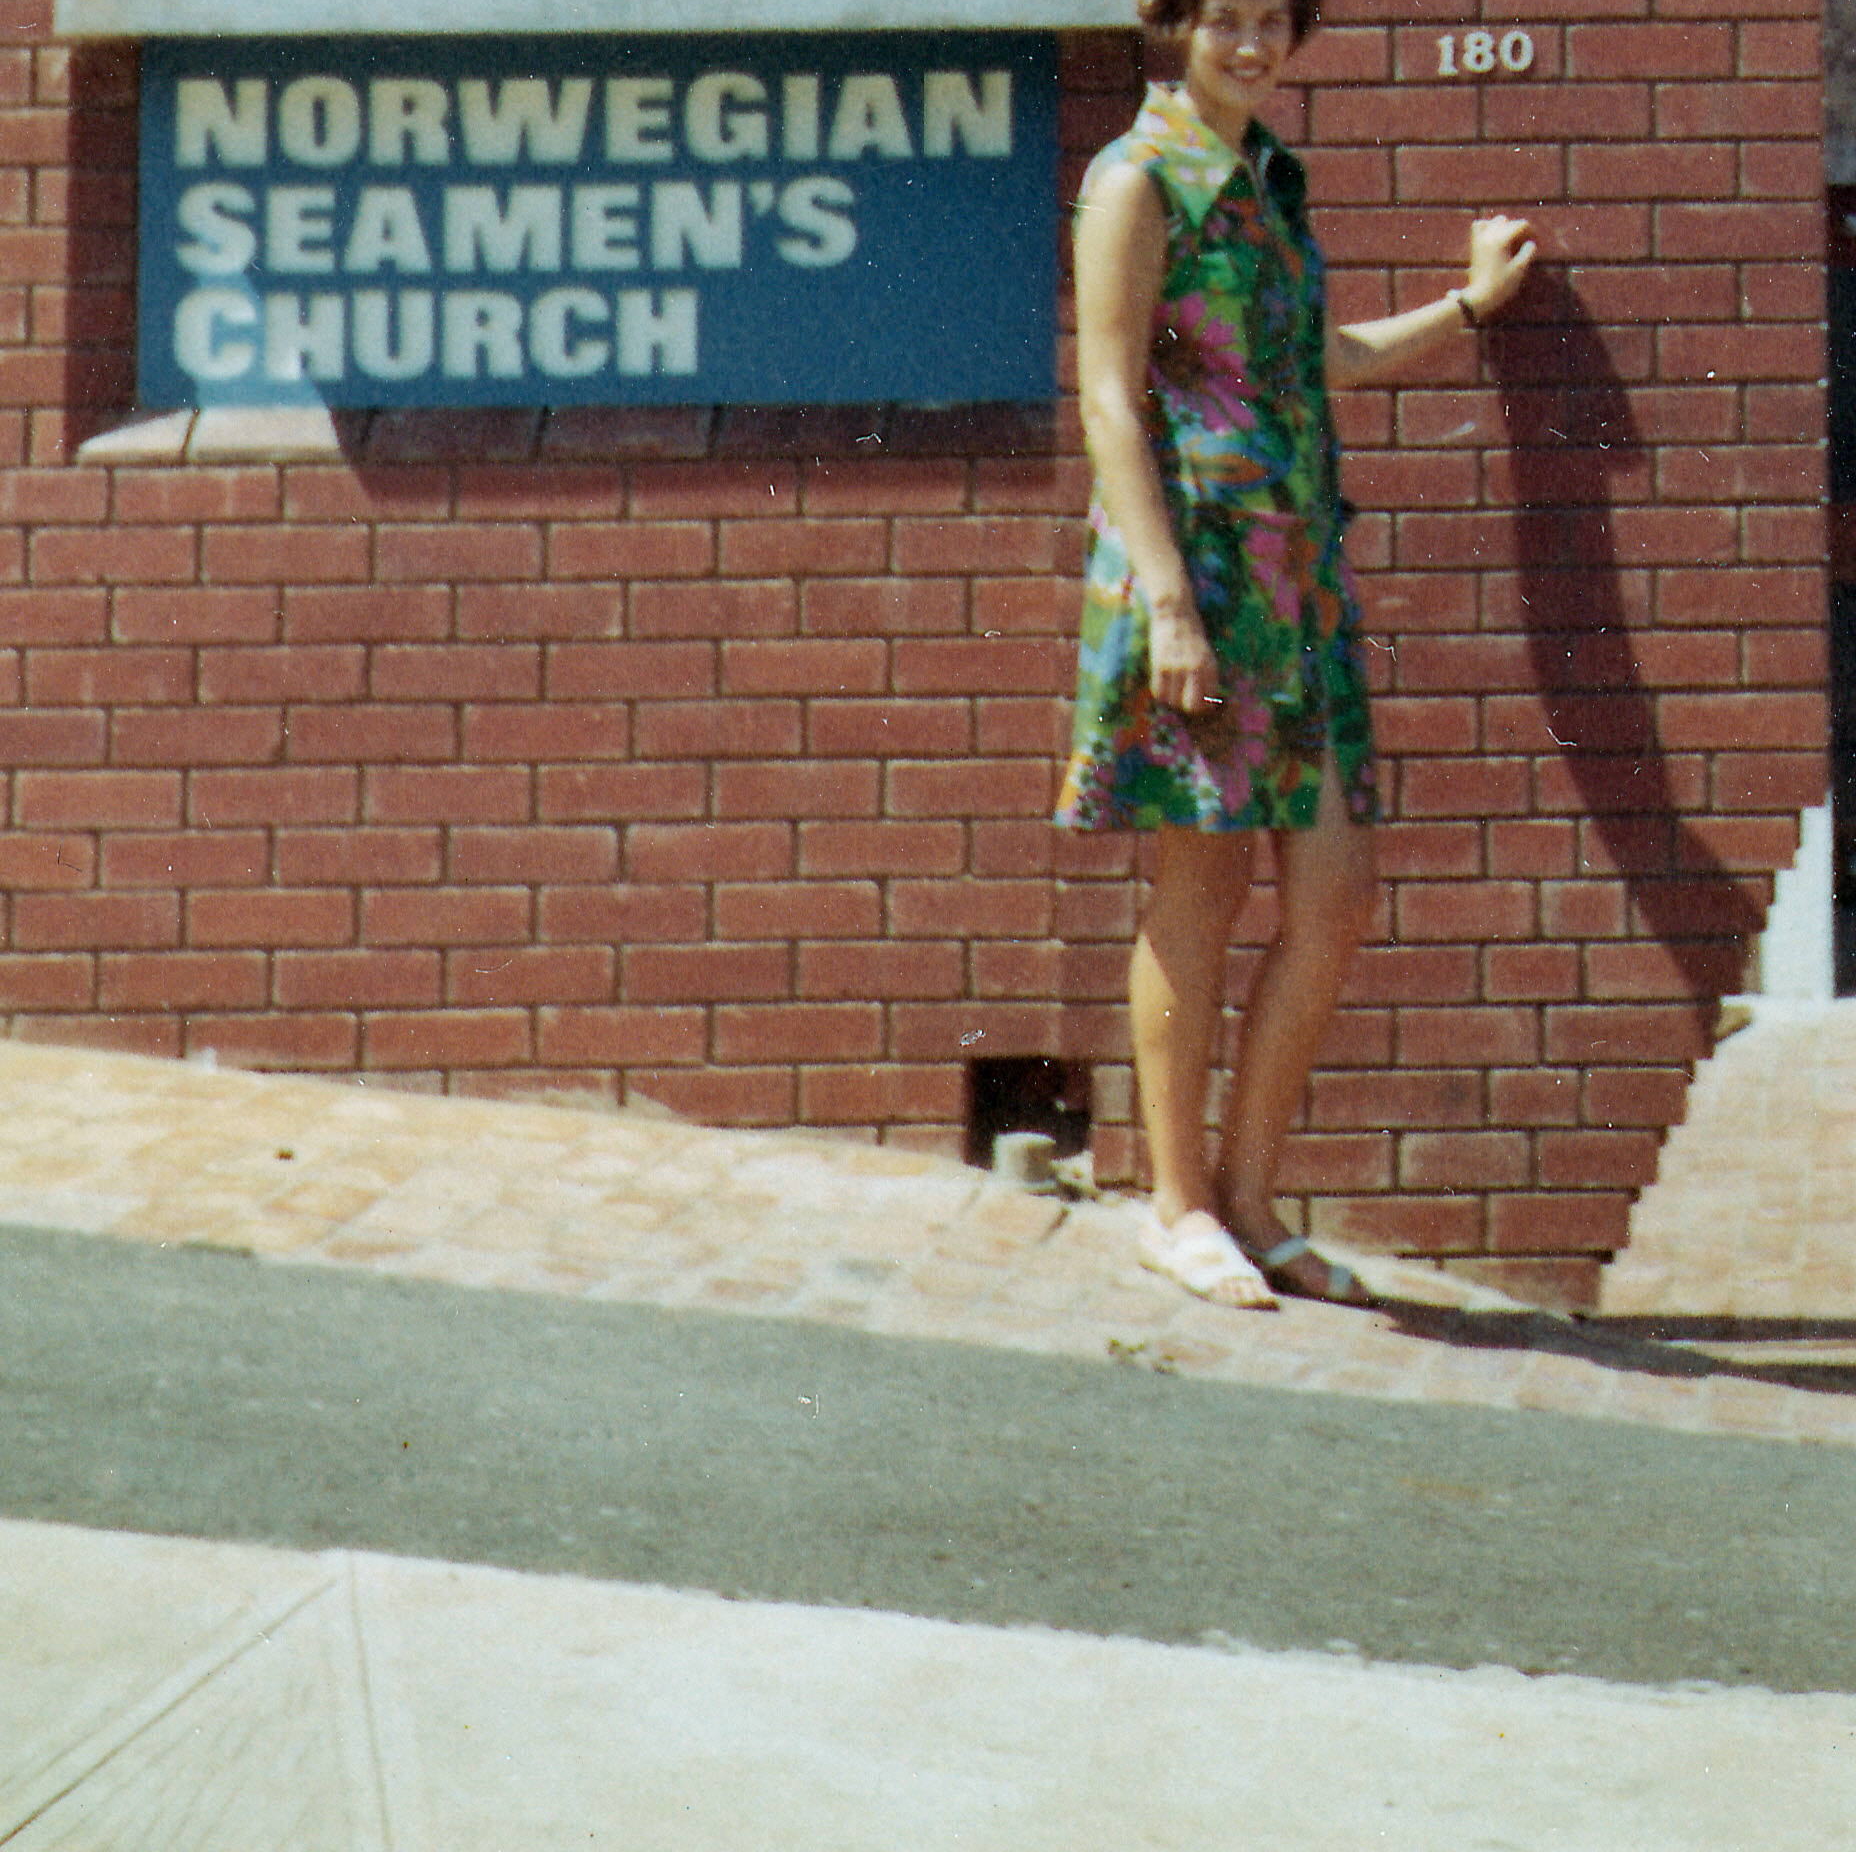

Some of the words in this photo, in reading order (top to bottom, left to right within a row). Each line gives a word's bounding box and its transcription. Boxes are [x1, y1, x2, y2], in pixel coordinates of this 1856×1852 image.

[1437, 29, 1535, 77] 180
[174, 70, 1014, 168] NORWEGIAN
[175, 175, 859, 276] SEAMEN'S
[172, 286, 700, 382] CHURCH
